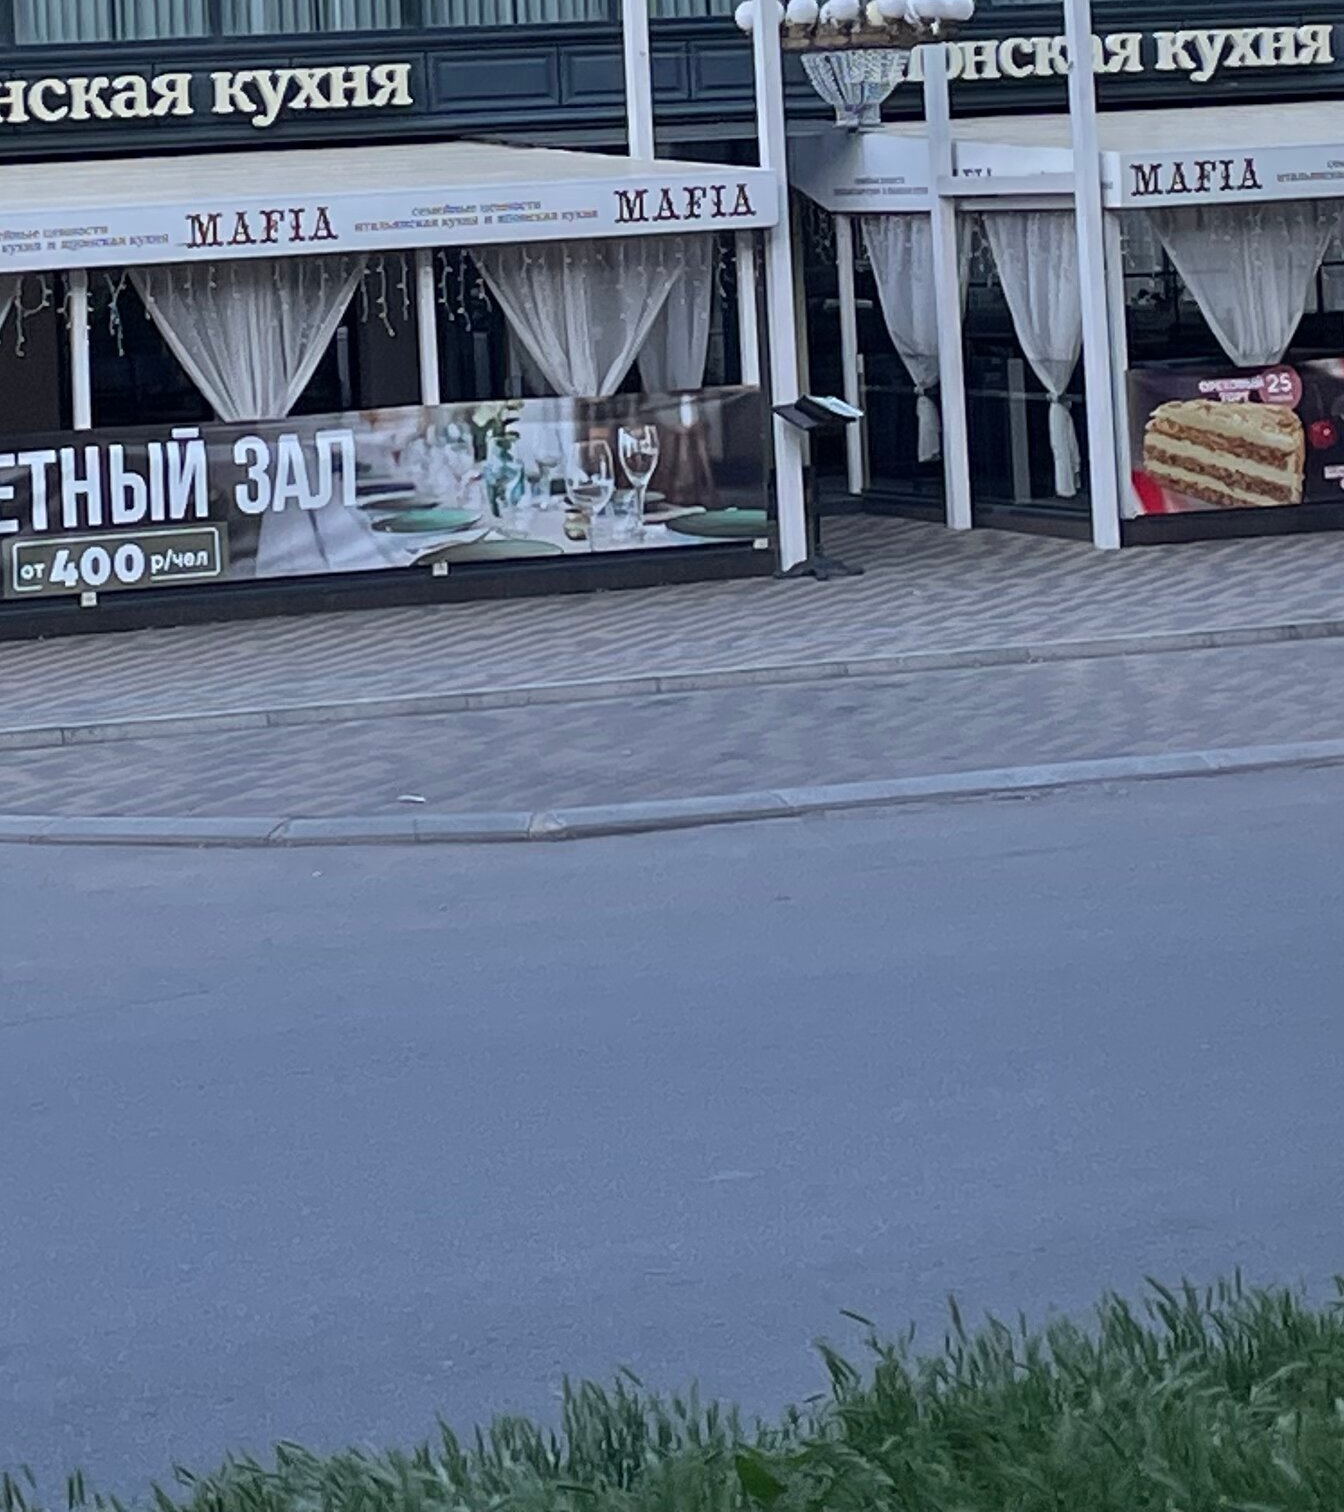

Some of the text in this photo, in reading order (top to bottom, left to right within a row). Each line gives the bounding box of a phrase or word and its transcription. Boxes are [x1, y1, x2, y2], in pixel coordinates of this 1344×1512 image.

[1154, 25, 1334, 82] кухня
[211, 62, 414, 127] кухня
[1130, 158, 1263, 197] MAFIA
[614, 183, 756, 224] MAFIA
[185, 206, 338, 249] MAFIA
[1265, 372, 1292, 393] 25
[233, 428, 356, 515] ЗАЛ
[19, 544, 209, 589] от 400 р/чел
